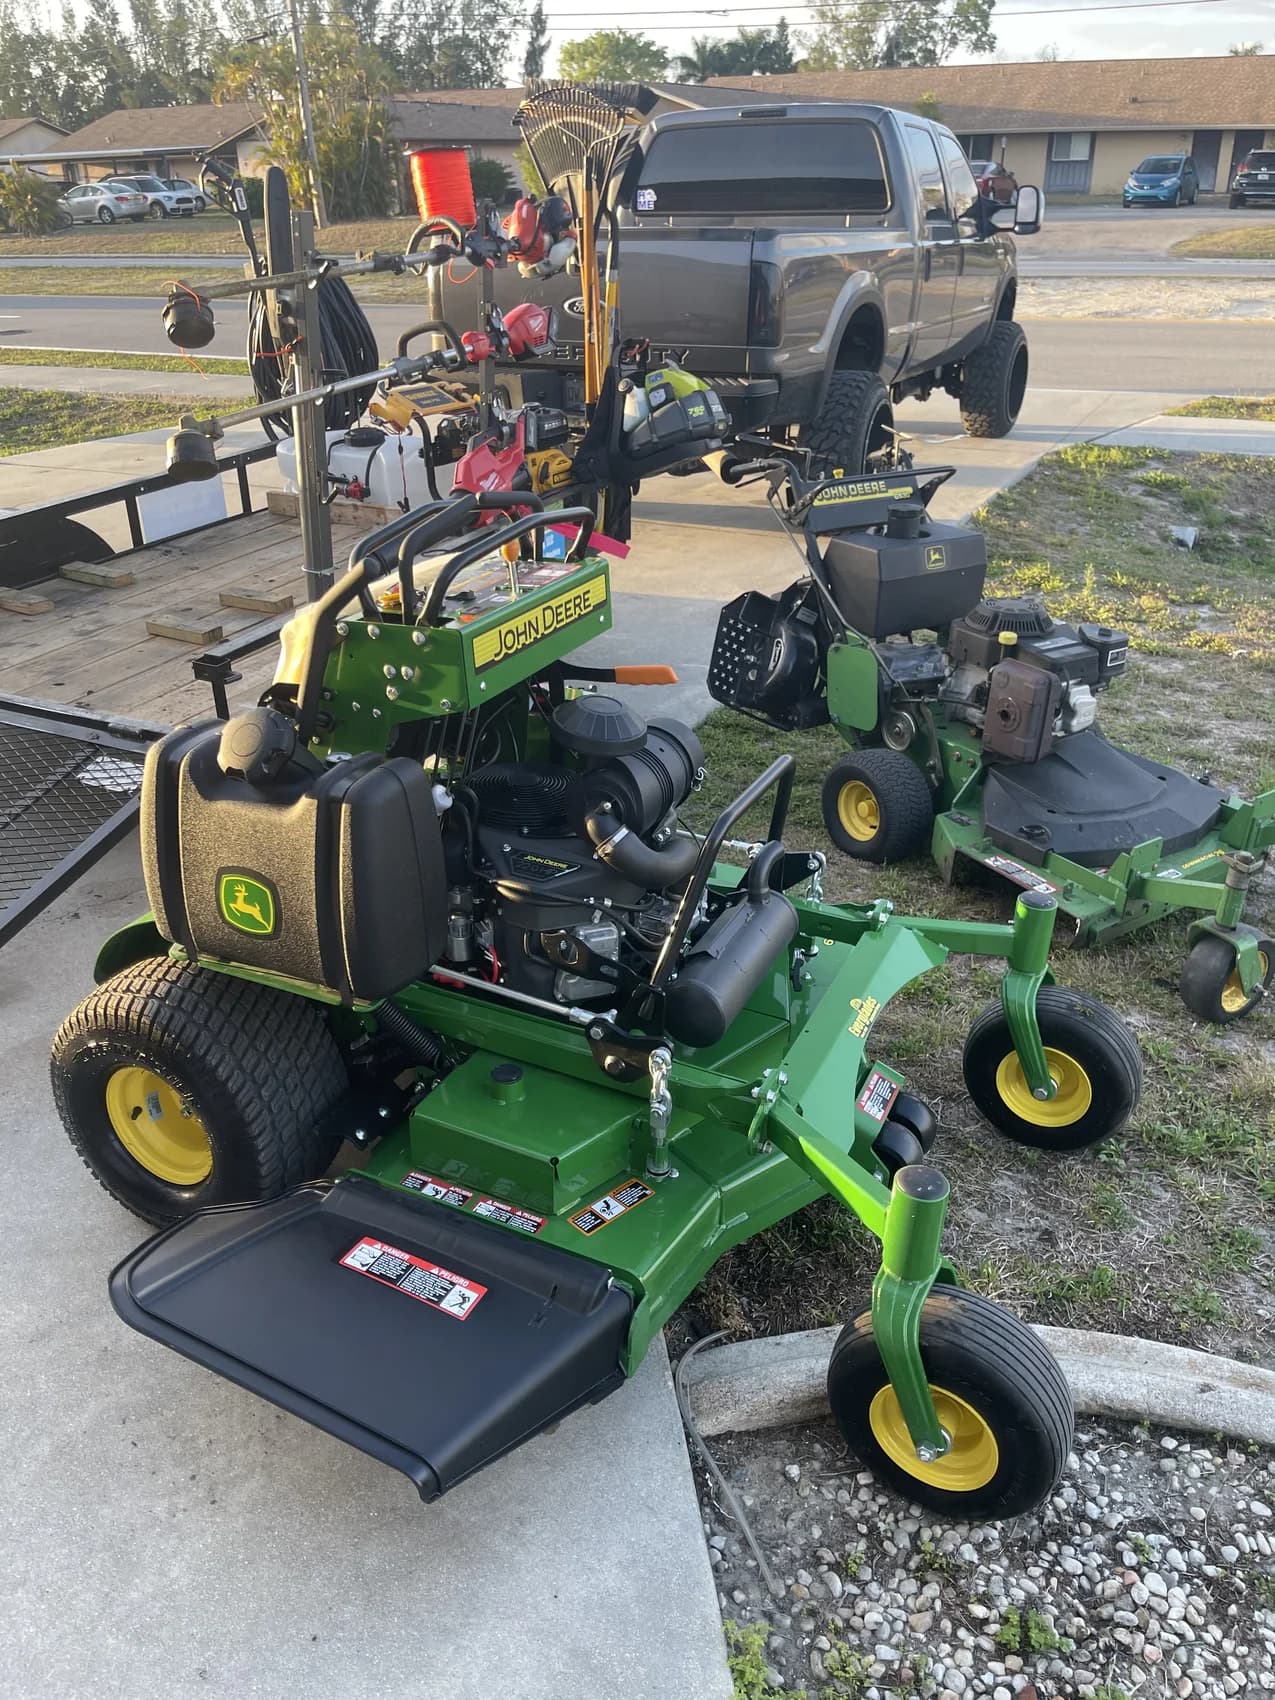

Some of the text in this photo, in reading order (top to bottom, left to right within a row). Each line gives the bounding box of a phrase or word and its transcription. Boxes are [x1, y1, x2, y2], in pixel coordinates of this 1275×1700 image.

[849, 481, 887, 496] DEERE
[494, 590, 592, 658] JOHN DEERE
[381, 1244, 410, 1261] DANGER
[439, 1267, 469, 1287] PELIGRO
